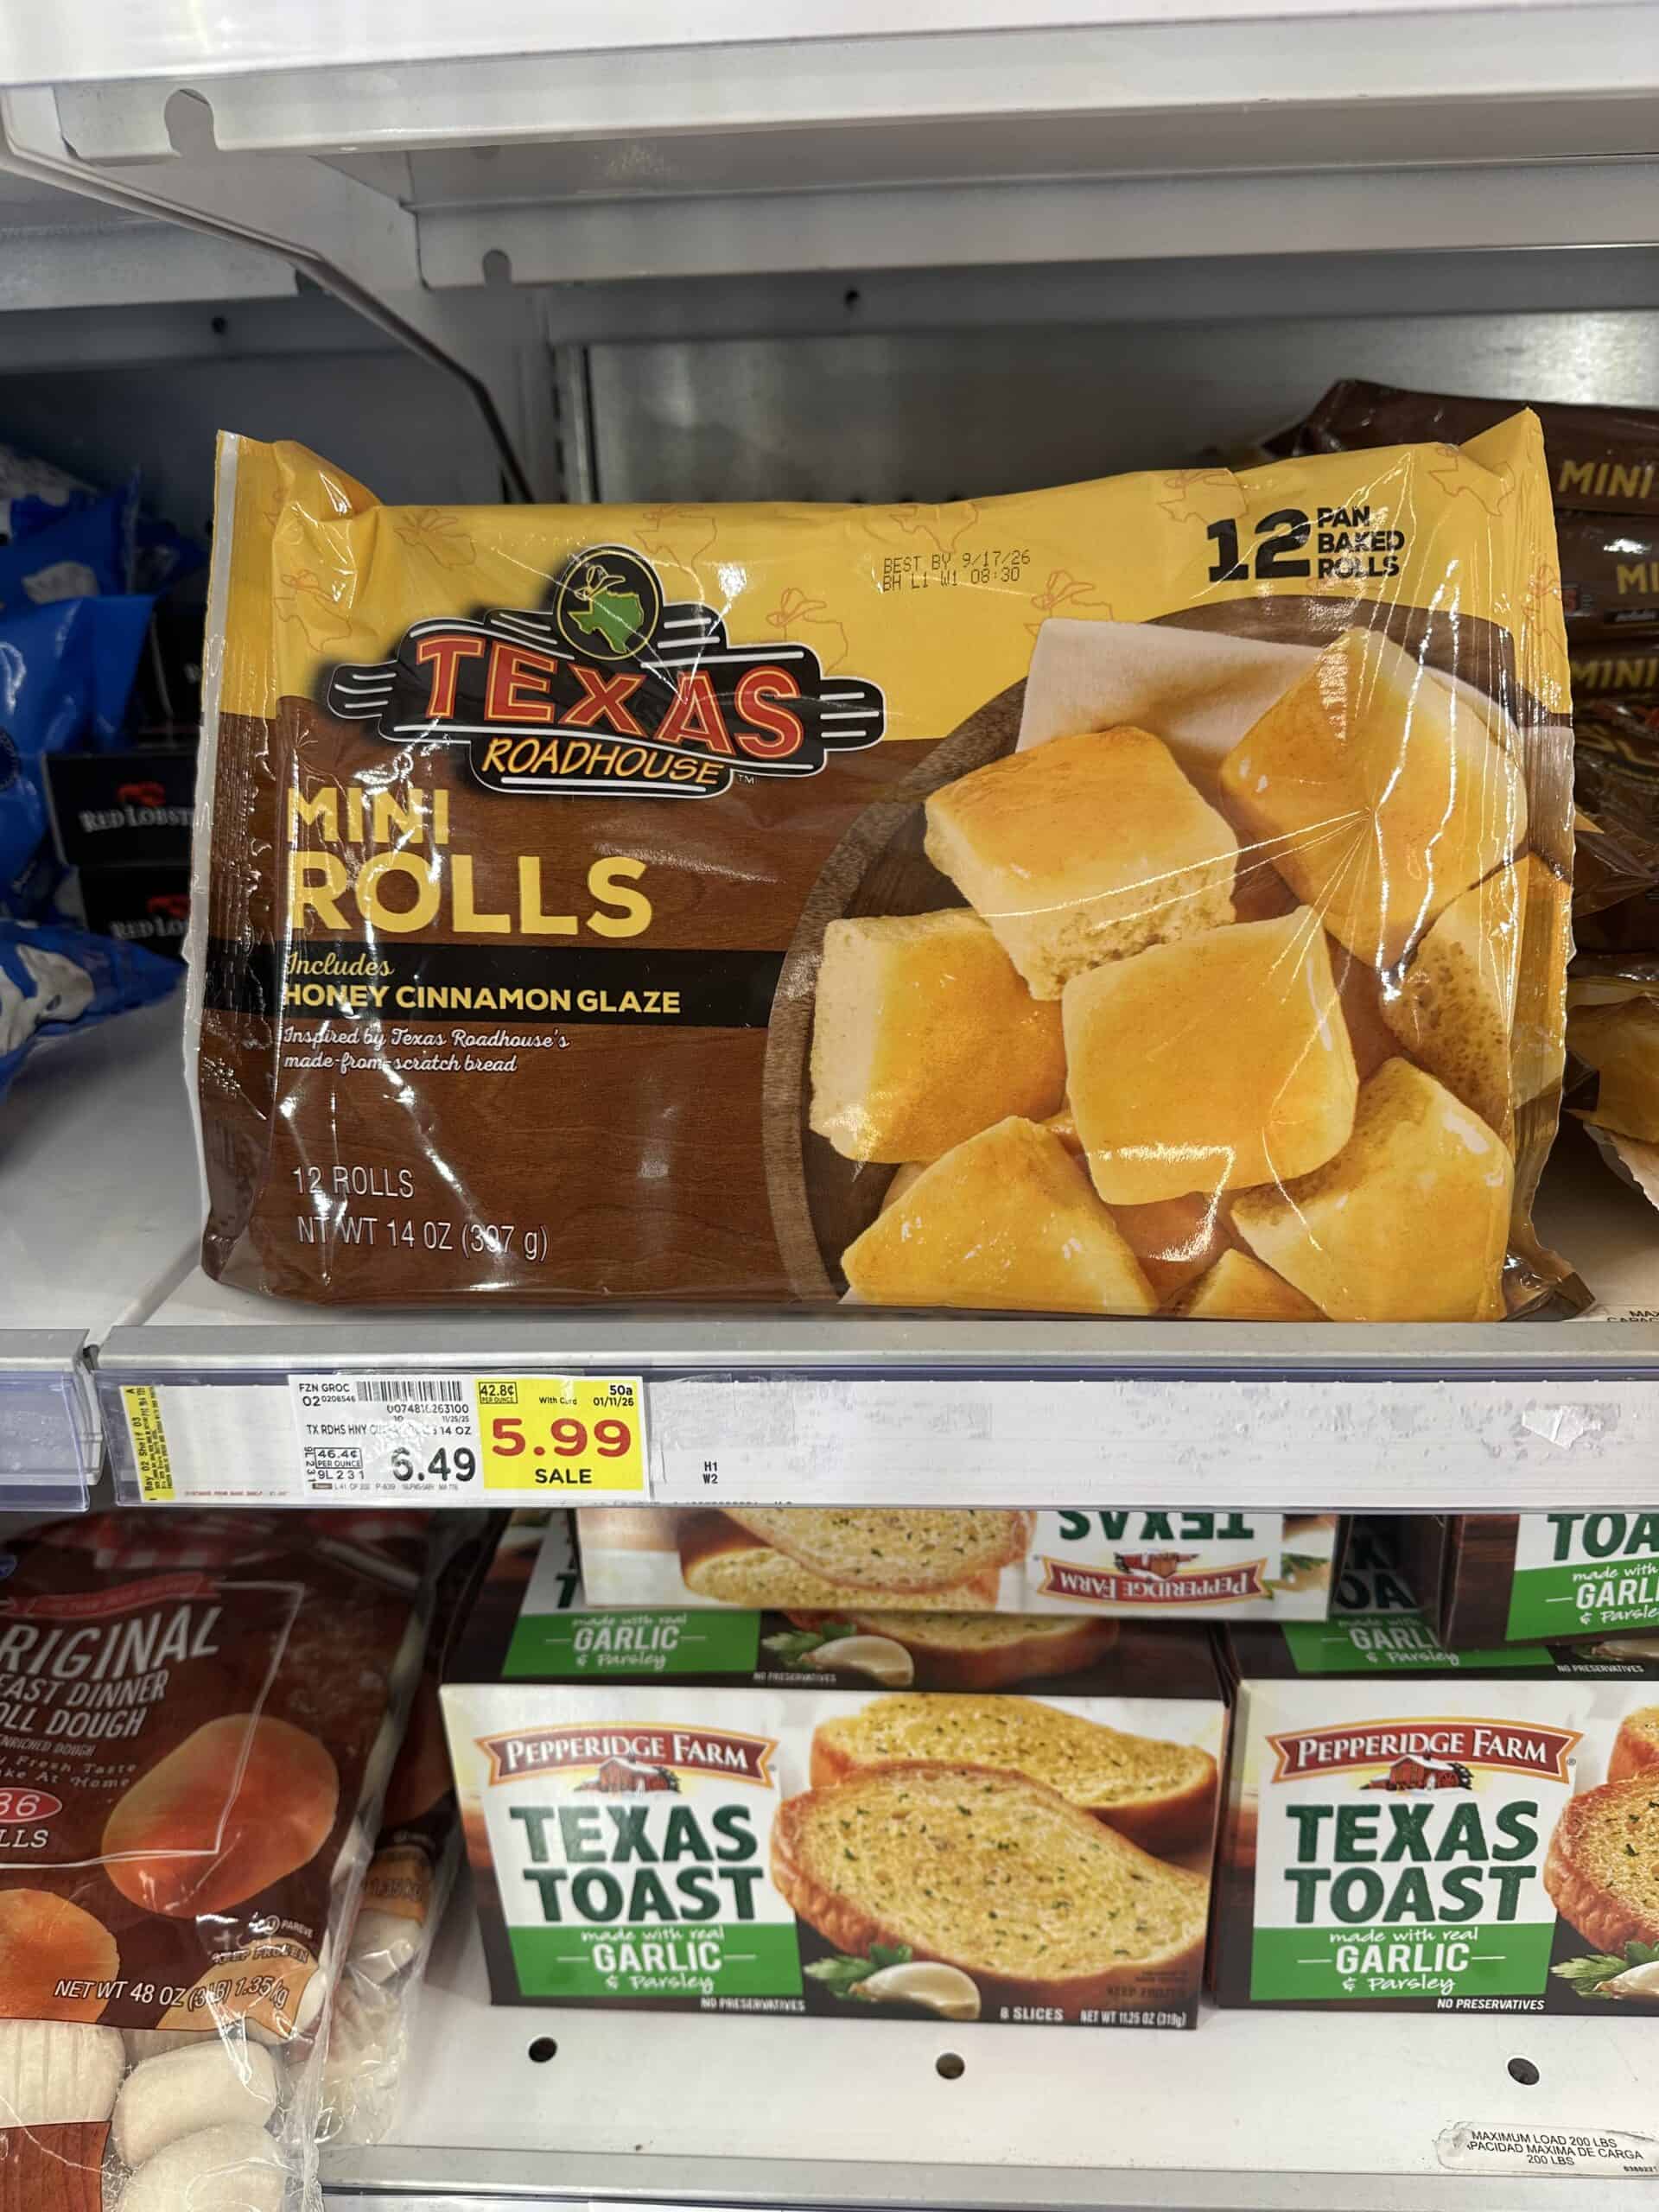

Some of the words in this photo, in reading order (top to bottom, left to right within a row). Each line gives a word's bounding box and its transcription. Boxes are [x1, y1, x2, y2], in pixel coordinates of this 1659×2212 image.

[1558, 459, 1655, 499] MINI
[1317, 505, 1371, 528] PAN
[1207, 508, 1311, 582] 12
[1317, 531, 1405, 554] BAKED
[884, 556, 922, 575] BEST
[931, 552, 950, 570] BY
[962, 550, 1031, 568] 9/17/26
[1317, 556, 1400, 579] ROLLS
[883, 575, 901, 592] BH
[970, 566, 1020, 585] 08:30
[416, 633, 807, 760] TEXAS
[481, 737, 725, 785] ROADHOUSE
[287, 787, 449, 845] MINI
[287, 851, 653, 938] ROLLS
[286, 951, 395, 976] Includes
[282, 983, 390, 1008] HONEY
[396, 985, 571, 1012] CINNAMON
[577, 989, 681, 1014] GLAZE
[283, 1025, 360, 1049] Inspired
[363, 1026, 386, 1051] by
[391, 1027, 446, 1046] Texas
[451, 1028, 570, 1048] Roadhouse's
[283, 1052, 461, 1075] made-from-scratch
[464, 1054, 518, 1072] bread
[291, 1166, 323, 1194] 12
[333, 1166, 416, 1198] ROLLS
[297, 1216, 329, 1244] NT
[339, 1217, 378, 1245] WT
[387, 1221, 416, 1248] 14
[423, 1222, 454, 1250] OZ
[524, 1224, 550, 1262] g)
[298, 1383, 319, 1392] FZN
[321, 1383, 350, 1392] GROC
[480, 1384, 514, 1396] 42.8¢
[609, 1385, 632, 1395] 50a
[302, 1395, 321, 1407] 02
[539, 1396, 557, 1405] With
[593, 1396, 634, 1407] 01/11/26
[306, 1424, 319, 1434] TX
[321, 1424, 346, 1434] RDHS
[348, 1424, 366, 1434] HNY
[441, 1427, 452, 1435] 14
[455, 1427, 472, 1435] OZ
[492, 1417, 632, 1458] 5.99
[317, 1470, 334, 1479] 9L
[336, 1470, 345, 1479] 2
[347, 1470, 355, 1479] 3
[535, 1468, 593, 1484] SALE
[704, 1461, 717, 1471] H1
[702, 1473, 718, 1484] W2
[1060, 1571, 1116, 1599] FARM
[1123, 1573, 1248, 1597] PEPPERIDGE
[1573, 1566, 1618, 1582] made
[574, 1625, 680, 1651] GARLIC
[1573, 1665, 1644, 1674] PRESERVATIVES
[66, 1669, 169, 1708] DINNER
[46, 1707, 147, 1738] DOUGH
[0, 1734, 52, 1751] NRICHED
[54, 1742, 97, 1756] DOUGH
[506, 1735, 665, 1770] PEPPERIDGE
[673, 1734, 748, 1770] FARM
[1298, 1732, 1464, 1767] PEPPERIDGE
[1472, 1729, 1547, 1764] FARM
[16, 1755, 71, 1772] Fresh
[35, 1771, 59, 1783] At
[510, 1805, 758, 1863] TEXAS
[1286, 1801, 1539, 1863] TEXAS
[523, 1867, 764, 1922] TOAST
[1284, 1866, 1537, 1923] TOAST
[581, 1928, 635, 1942] made
[643, 1927, 683, 1942] with
[690, 1924, 725, 1941] real
[1330, 1928, 1386, 1943] made
[1393, 1927, 1434, 1942] with
[1442, 1926, 1478, 1942] real
[592, 1942, 722, 1973] GARLIC
[1336, 1942, 1470, 1974] GARLIC
[54, 1980, 98, 1999] NET
[97, 1980, 128, 1999] WT
[130, 1982, 154, 2004] 48
[158, 1986, 184, 2007] OZ
[629, 1973, 715, 1995] Parsley
[1369, 1974, 1456, 1995] Parsley
[701, 1998, 717, 2009] NO
[719, 1998, 805, 2012] PRESERVATIVES
[1014, 2007, 1064, 2021] SLICES
[1080, 2009, 1099, 2023] NET
[1102, 2010, 1117, 2024] WT
[1437, 1999, 1453, 2009] NO
[1455, 1999, 1545, 2011] PRESERVATIVES
[1471, 2131, 1530, 2144] MAXIMUM
[1533, 2134, 1567, 2145] LOAD
[1569, 2136, 1591, 2146] 200
[1593, 2138, 1617, 2148] LBS
[1527, 2145, 1575, 2157] MAXIMA
[1579, 2147, 1595, 2158] DE
[1598, 2148, 1643, 2160] CARGA
[1527, 2154, 1548, 2164] 200
[1550, 2157, 1575, 2165] LBS
